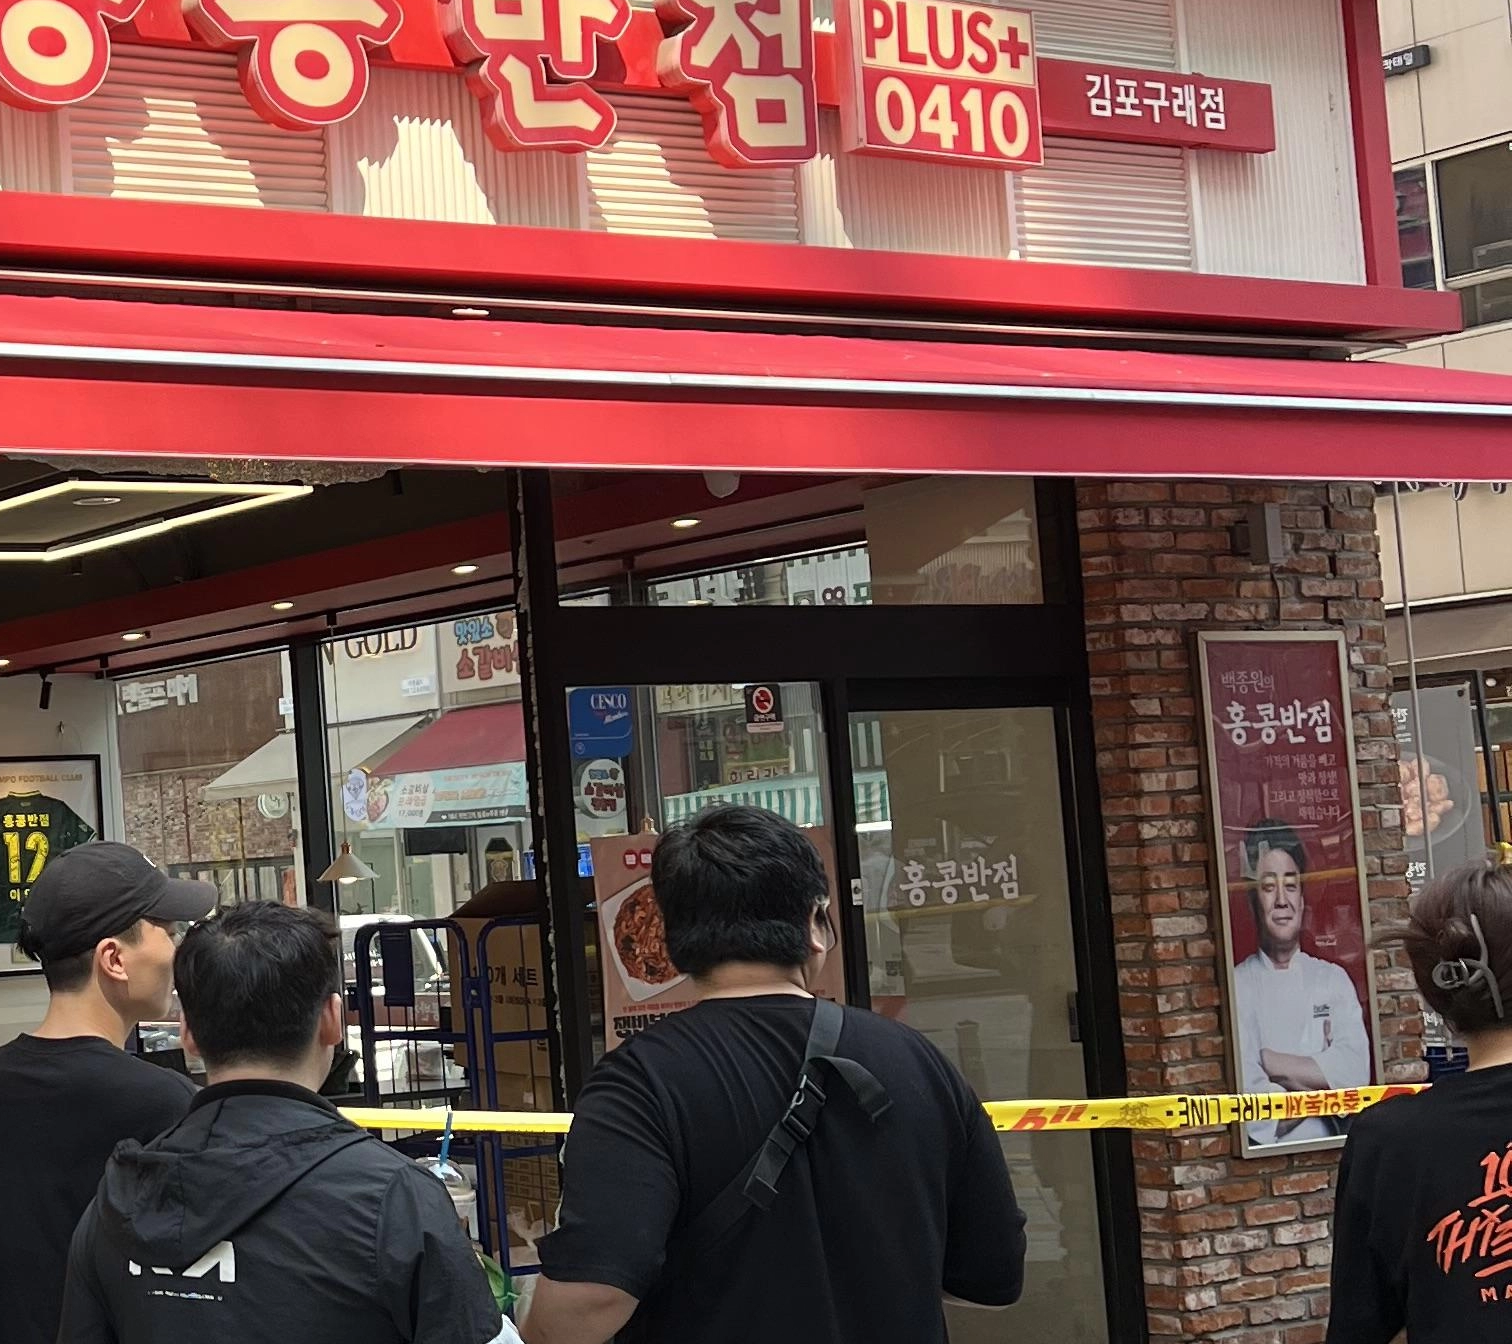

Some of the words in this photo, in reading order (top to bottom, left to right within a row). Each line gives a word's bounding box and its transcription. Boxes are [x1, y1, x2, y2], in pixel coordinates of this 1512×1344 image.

[874, 78, 1031, 159] 0410
[1085, 72, 1228, 131] 김포구래점
[344, 626, 418, 660] GOLD
[1220, 669, 1275, 695] 백종원의
[590, 693, 627, 710] CESCO
[1222, 697, 1333, 745] 홍콩반점
[18, 774, 60, 784] FOOTBALL
[3, 813, 50, 829] 홍콩반점
[2, 831, 50, 885] 12
[899, 853, 1020, 907] 홍콩반점
[1013, 1103, 1088, 1132] 119
